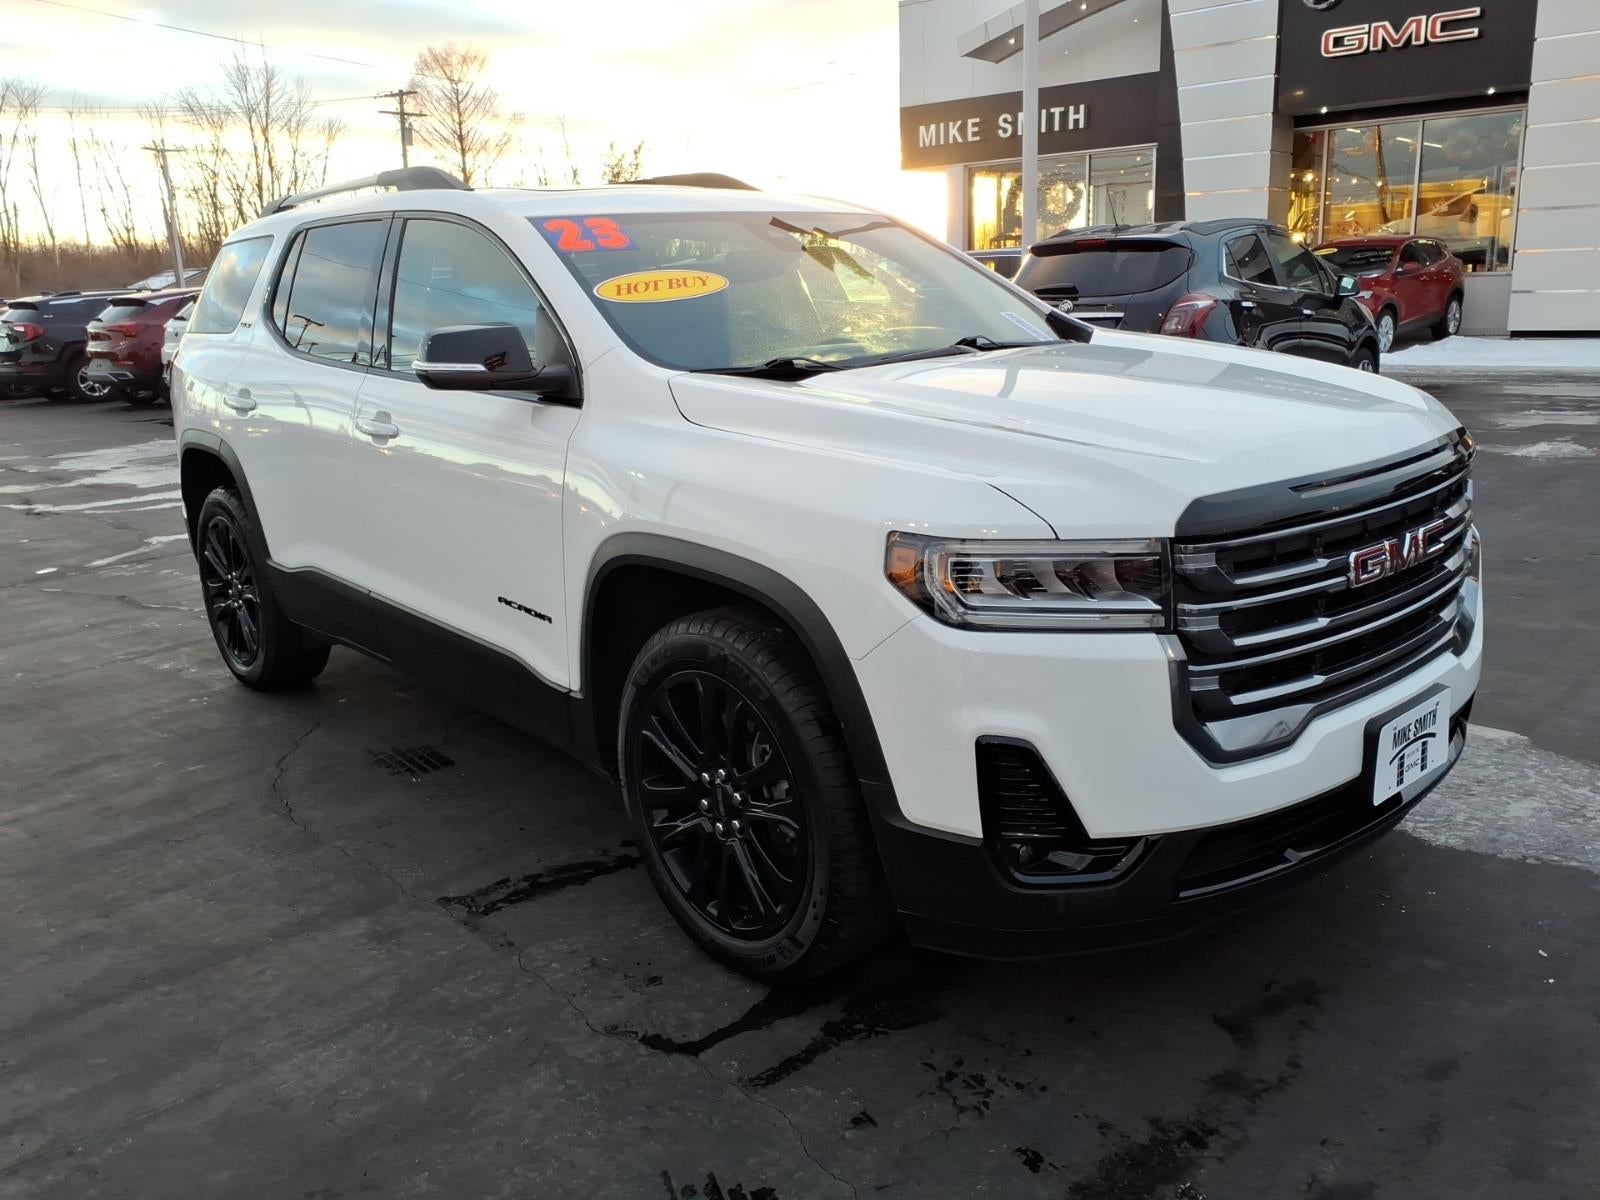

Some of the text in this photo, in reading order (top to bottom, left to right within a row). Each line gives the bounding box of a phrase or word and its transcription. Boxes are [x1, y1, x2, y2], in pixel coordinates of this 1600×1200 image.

[1320, 7, 1481, 57] GMC
[919, 117, 981, 148] MIKE
[543, 216, 630, 252] 23
[615, 275, 710, 297] HOT BUY
[1348, 519, 1446, 588] GMC
[1391, 707, 1438, 751] MIKE SMITH
